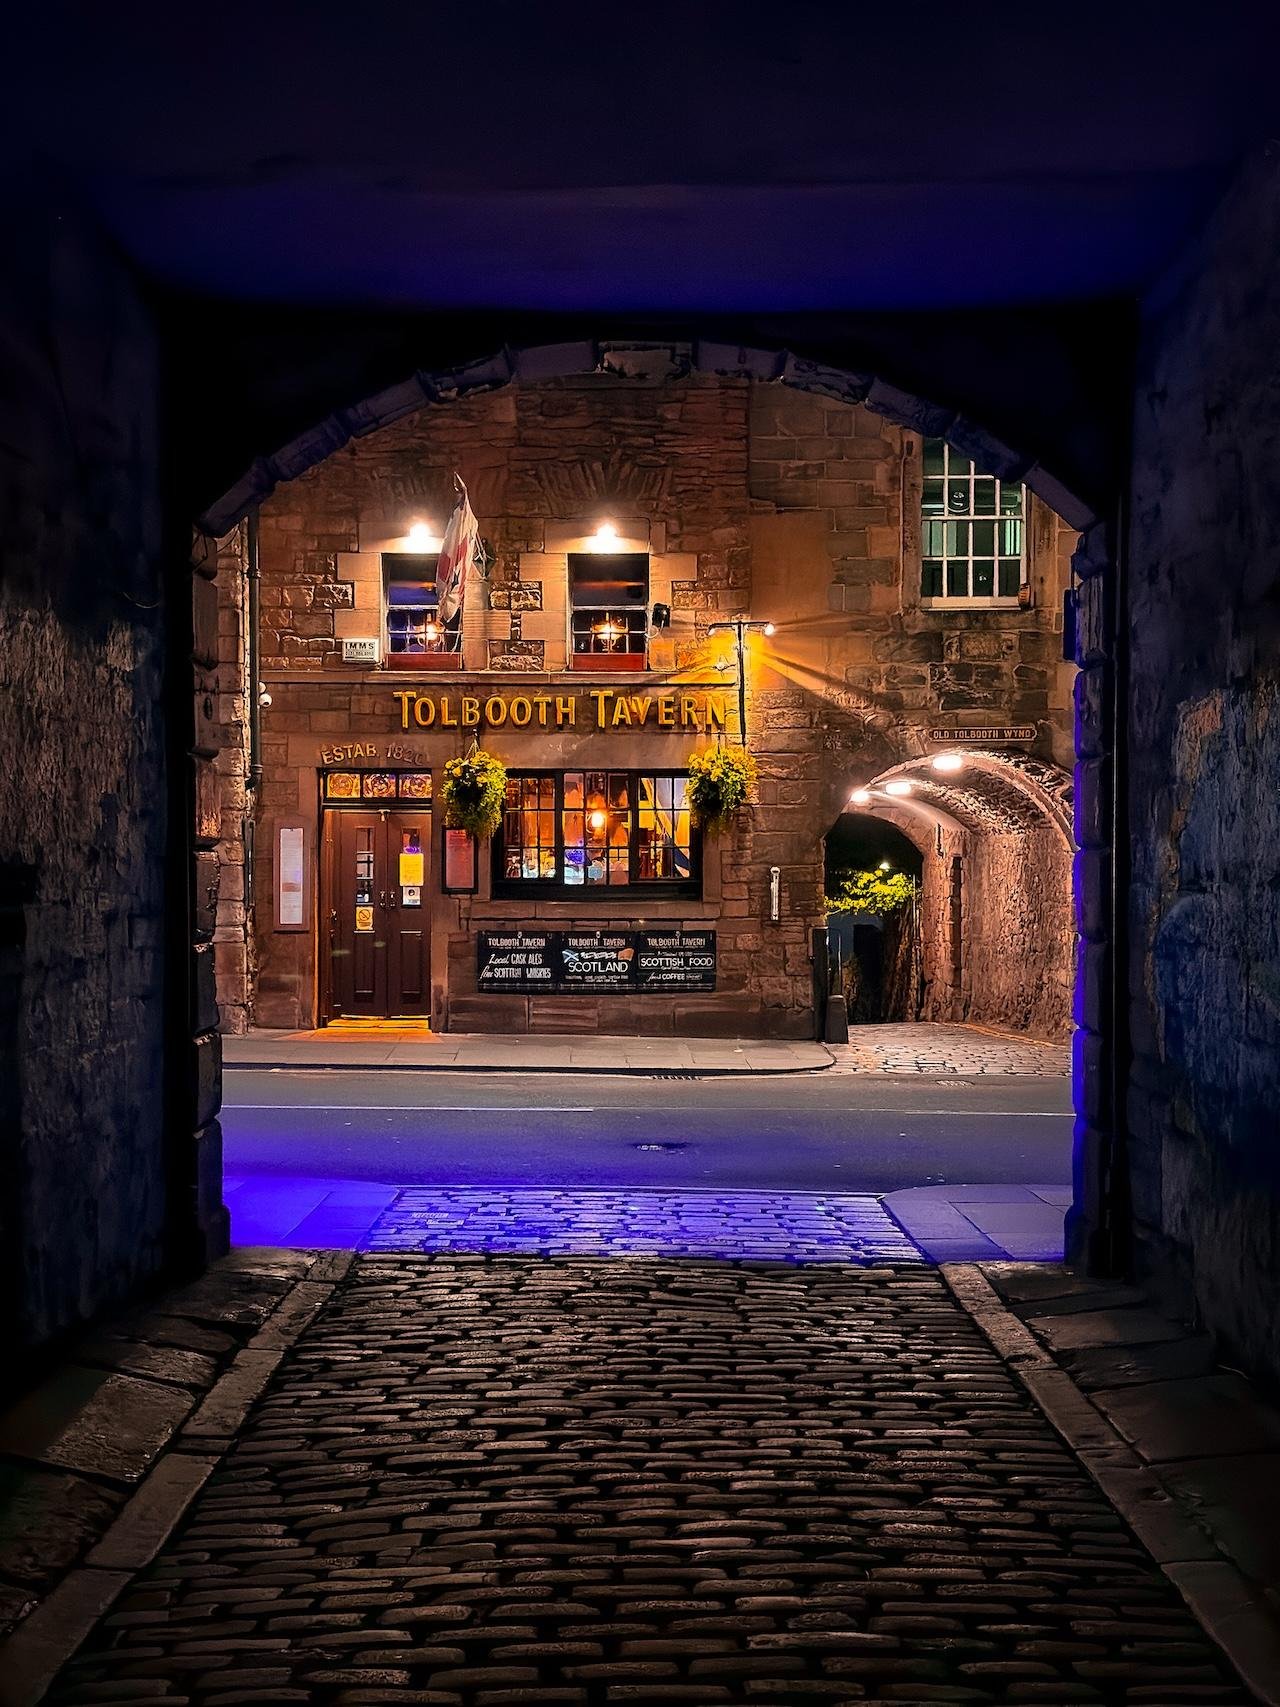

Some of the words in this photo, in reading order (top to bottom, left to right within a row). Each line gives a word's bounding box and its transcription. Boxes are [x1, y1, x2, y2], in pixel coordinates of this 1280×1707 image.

[345, 641, 374, 650] IMMS
[393, 690, 577, 729] TOLBOOTH
[590, 690, 727, 730] TAVERN
[933, 730, 950, 739] OLD
[954, 730, 999, 739] TOLBOOTH
[1003, 729, 1031, 738] WYND
[321, 743, 380, 765] ESTAB.
[488, 938, 520, 947] TOLBOOTH
[521, 938, 546, 947] TAVERN
[568, 938, 599, 947] TOLBOOTH
[603, 938, 626, 947] TAVERN
[647, 937, 680, 946] TOLBOOTH
[682, 937, 706, 946] TAVERN
[510, 953, 527, 965] CASK
[528, 953, 543, 965] ALES
[640, 957, 684, 967] SCOTTISH
[689, 957, 713, 967] FOOD
[568, 961, 629, 973] SCOTLAND
